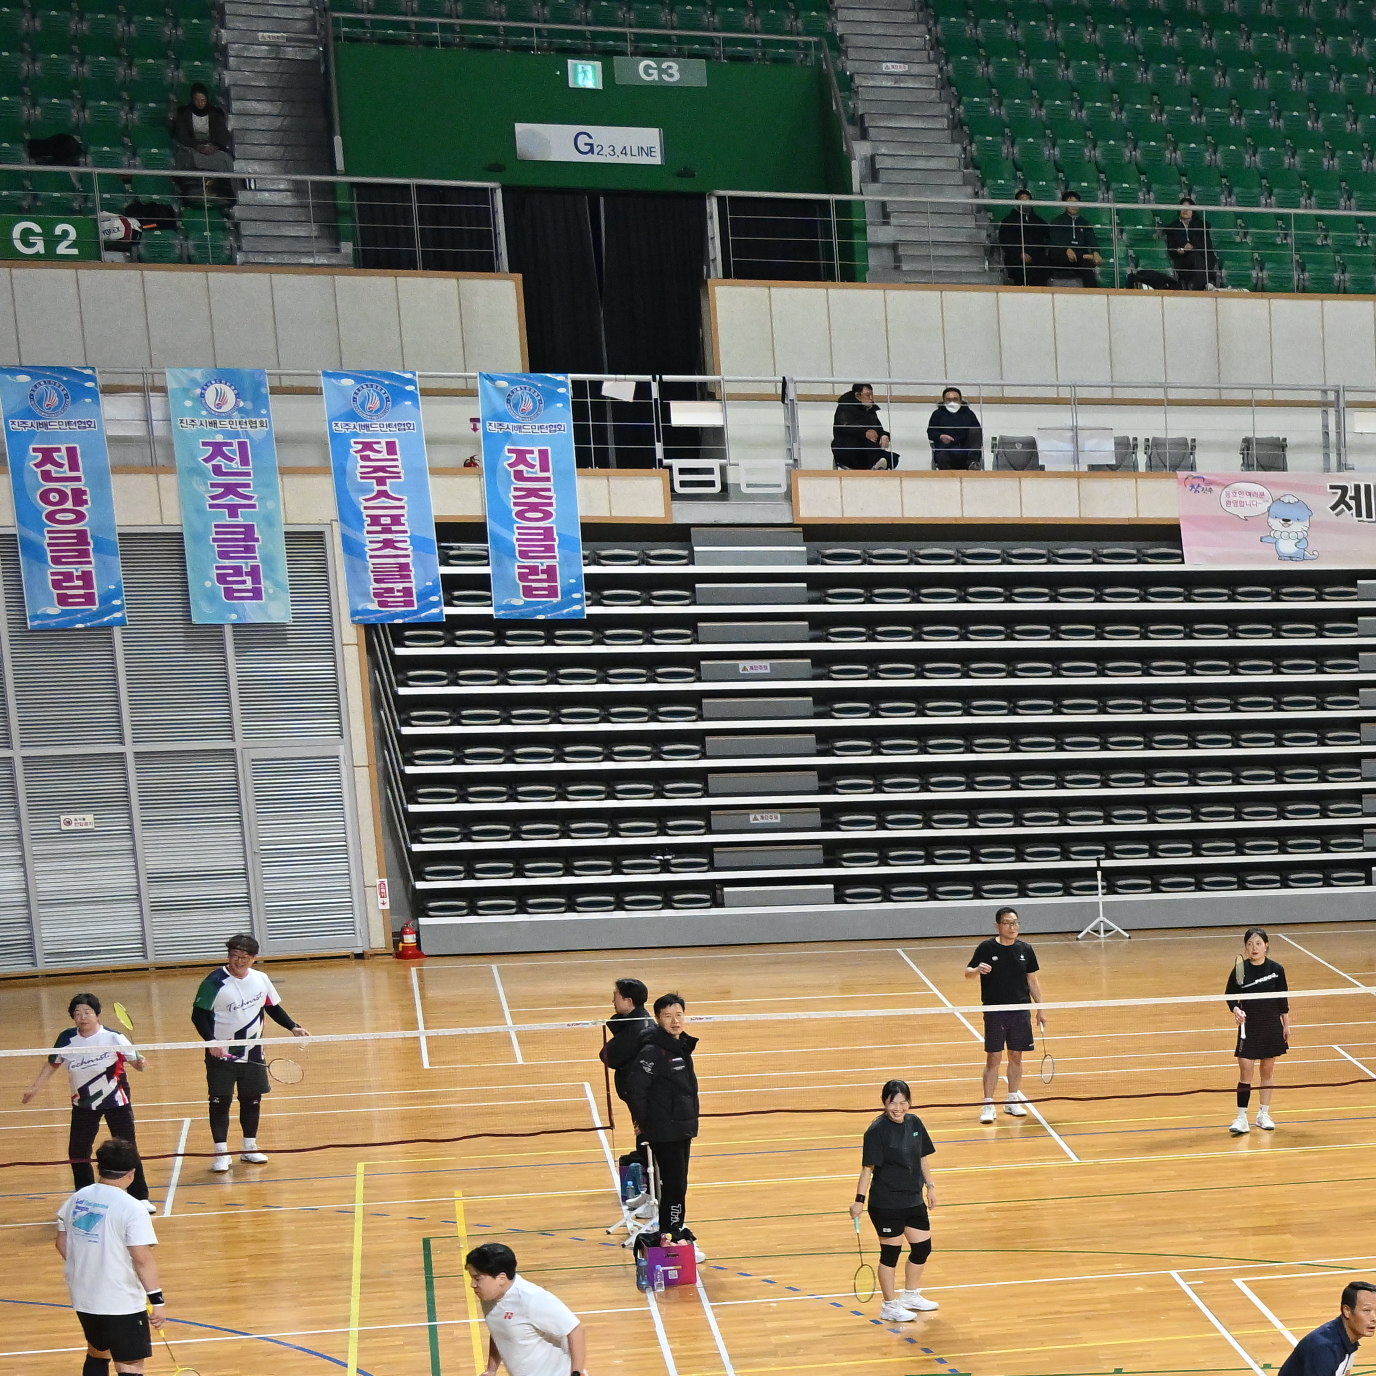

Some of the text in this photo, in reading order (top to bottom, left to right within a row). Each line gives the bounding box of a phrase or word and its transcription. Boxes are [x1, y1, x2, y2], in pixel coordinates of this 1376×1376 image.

[638, 60, 681, 82] G3
[12, 221, 79, 255] G2
[9, 420, 97, 431] 진주시배드민턴협회
[178, 418, 269, 430] 진주시배드민턴협회
[332, 422, 416, 433] 진주시배드민턴협회
[487, 422, 566, 433] 진주시배드민턴협회
[31, 445, 98, 608] 진양클럽
[200, 439, 265, 603] 진주클럽
[352, 439, 417, 610] 진주스포츠클럽
[505, 446, 561, 600] 진중클럽
